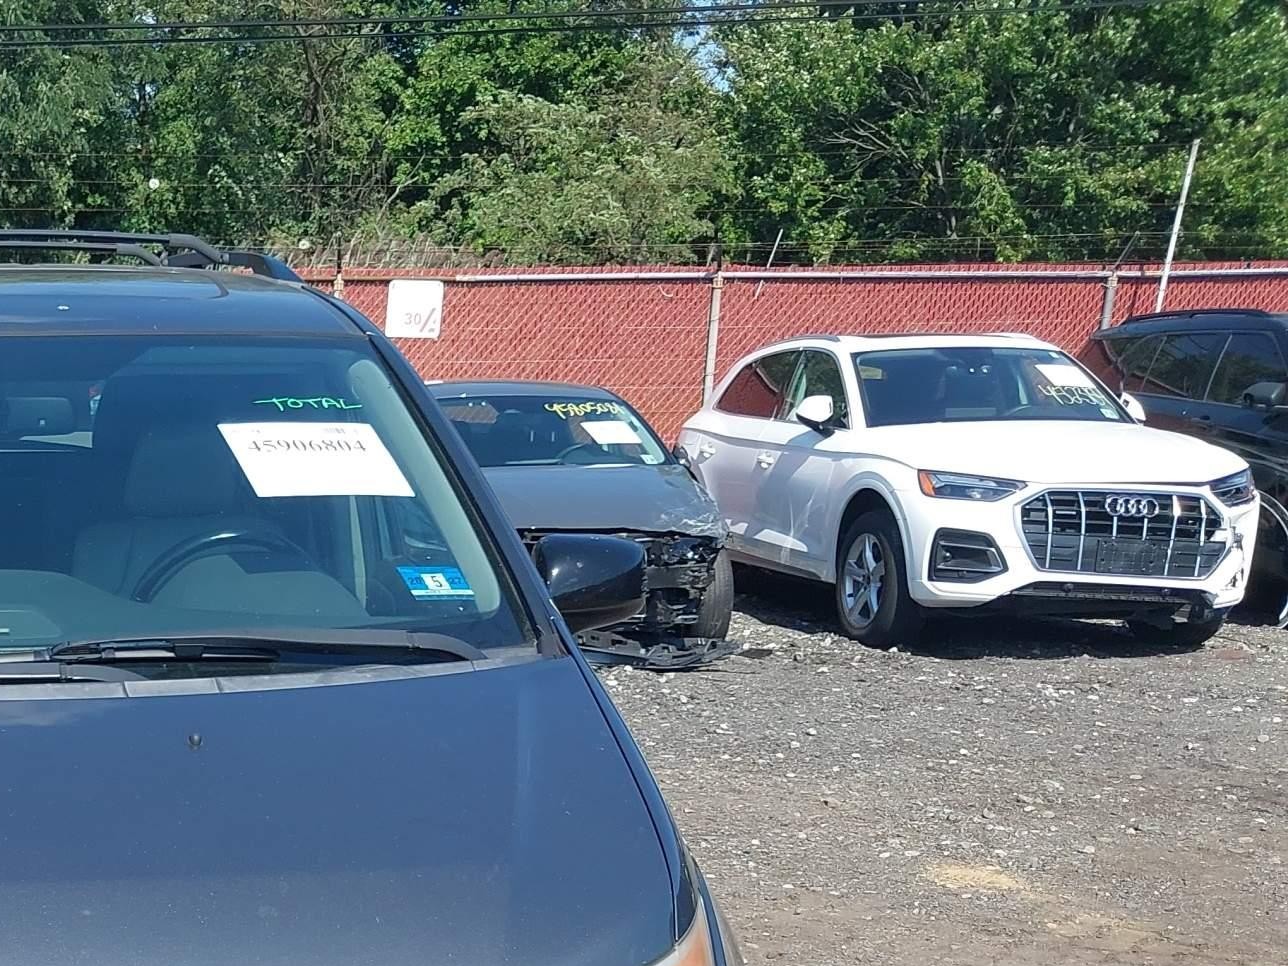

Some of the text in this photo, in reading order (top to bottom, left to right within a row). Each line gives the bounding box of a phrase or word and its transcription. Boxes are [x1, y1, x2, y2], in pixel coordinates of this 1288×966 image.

[253, 397, 363, 412] TOTAL
[248, 439, 367, 452] 45906804
[430, 575, 443, 588] 5
